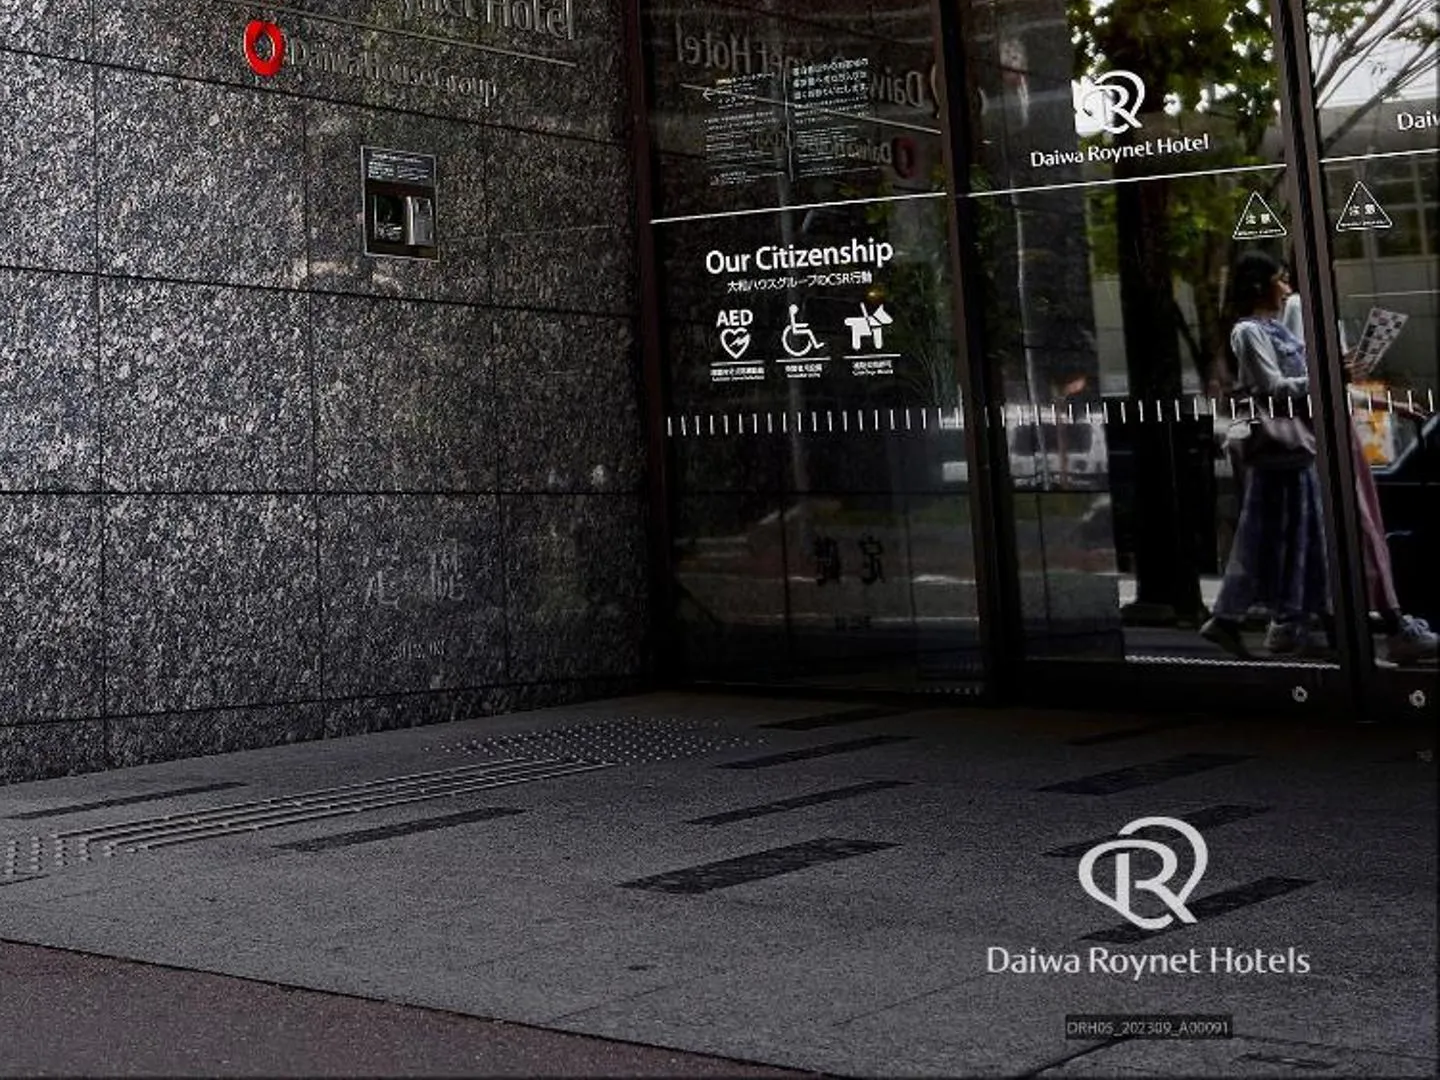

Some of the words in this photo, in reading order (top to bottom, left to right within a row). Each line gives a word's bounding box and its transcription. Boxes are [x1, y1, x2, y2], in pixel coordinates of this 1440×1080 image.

[1030, 149, 1084, 167] Daiwa
[1088, 141, 1154, 163] Roynet
[1157, 133, 1209, 153] Hotel
[706, 249, 751, 274] Our
[755, 236, 894, 268] Citizenship
[715, 309, 753, 327] AED
